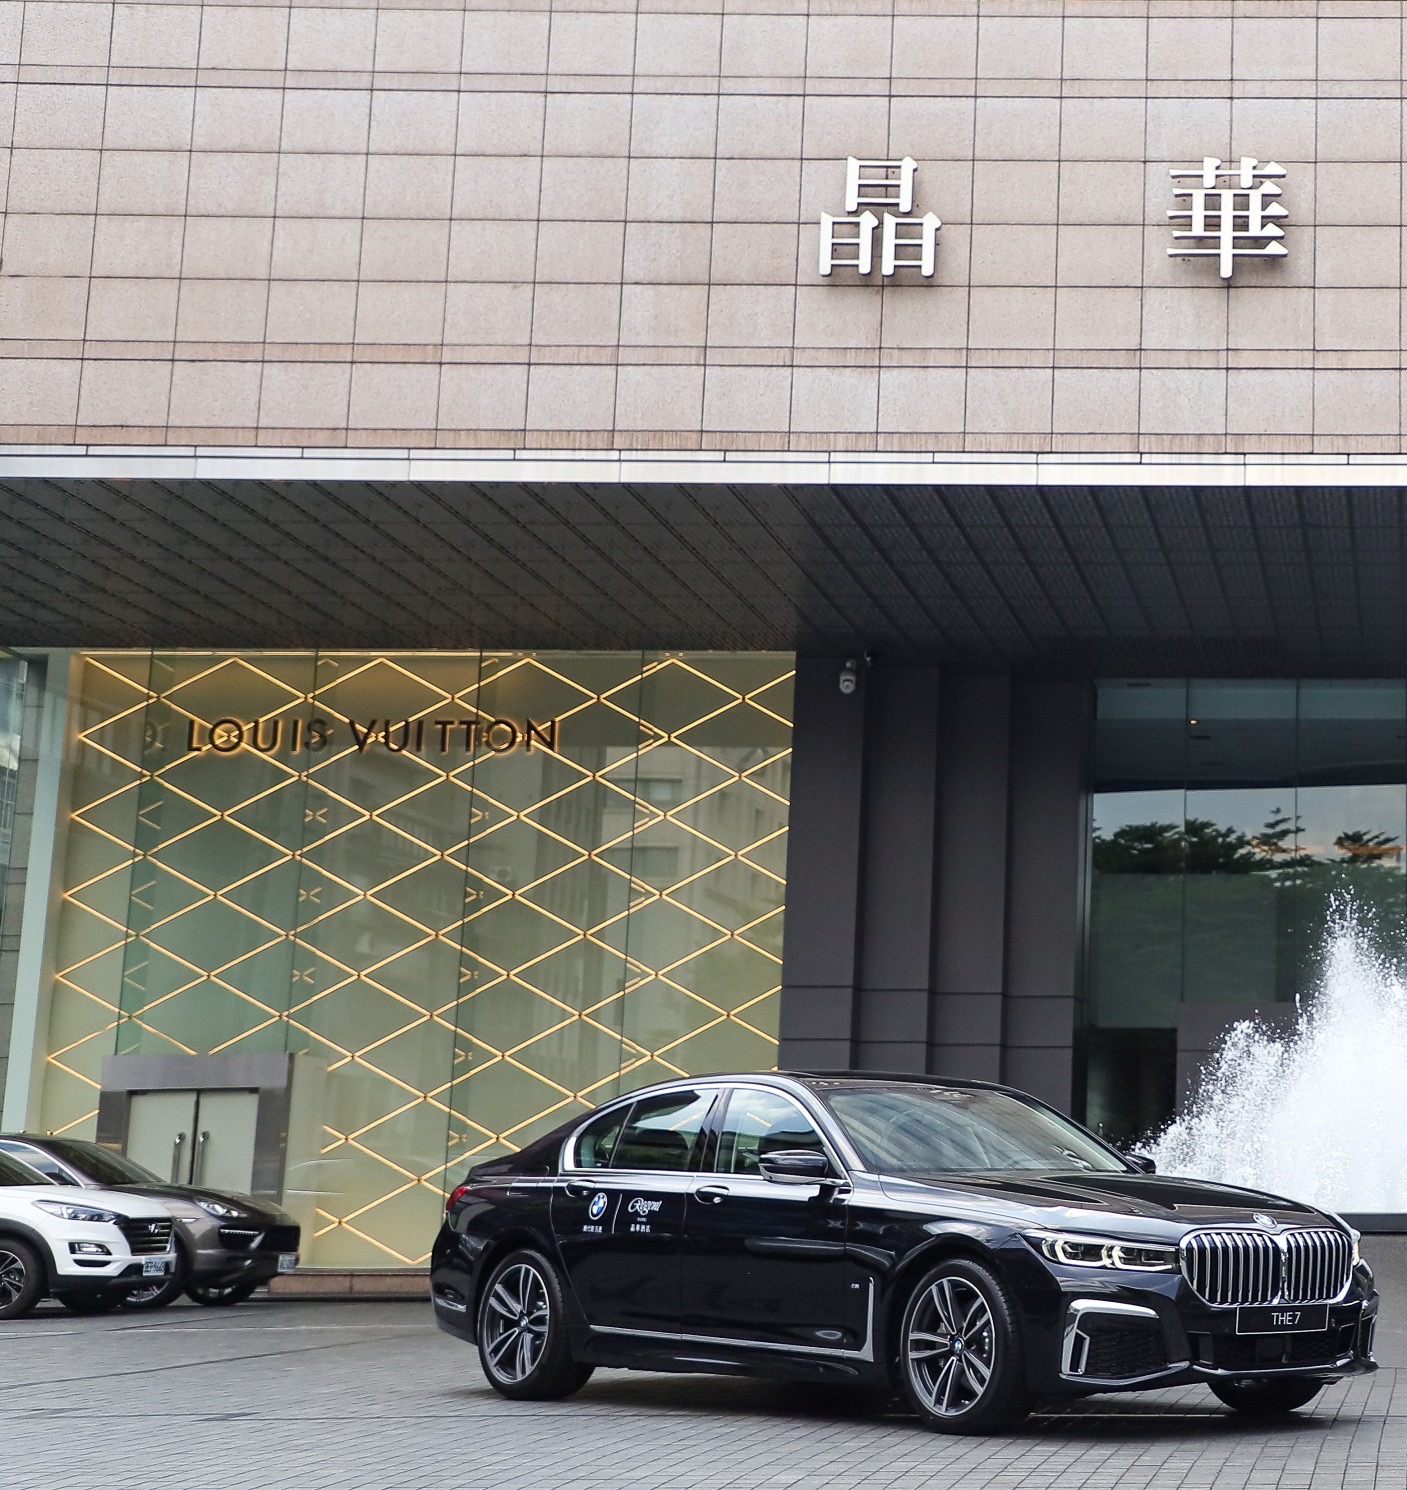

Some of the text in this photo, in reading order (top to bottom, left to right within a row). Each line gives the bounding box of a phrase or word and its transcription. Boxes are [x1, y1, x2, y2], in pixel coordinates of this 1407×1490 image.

[187, 717, 560, 754] LOUIS VUITTON
[628, 1197, 663, 1216] Regent
[1271, 1312, 1301, 1326] THE 7
